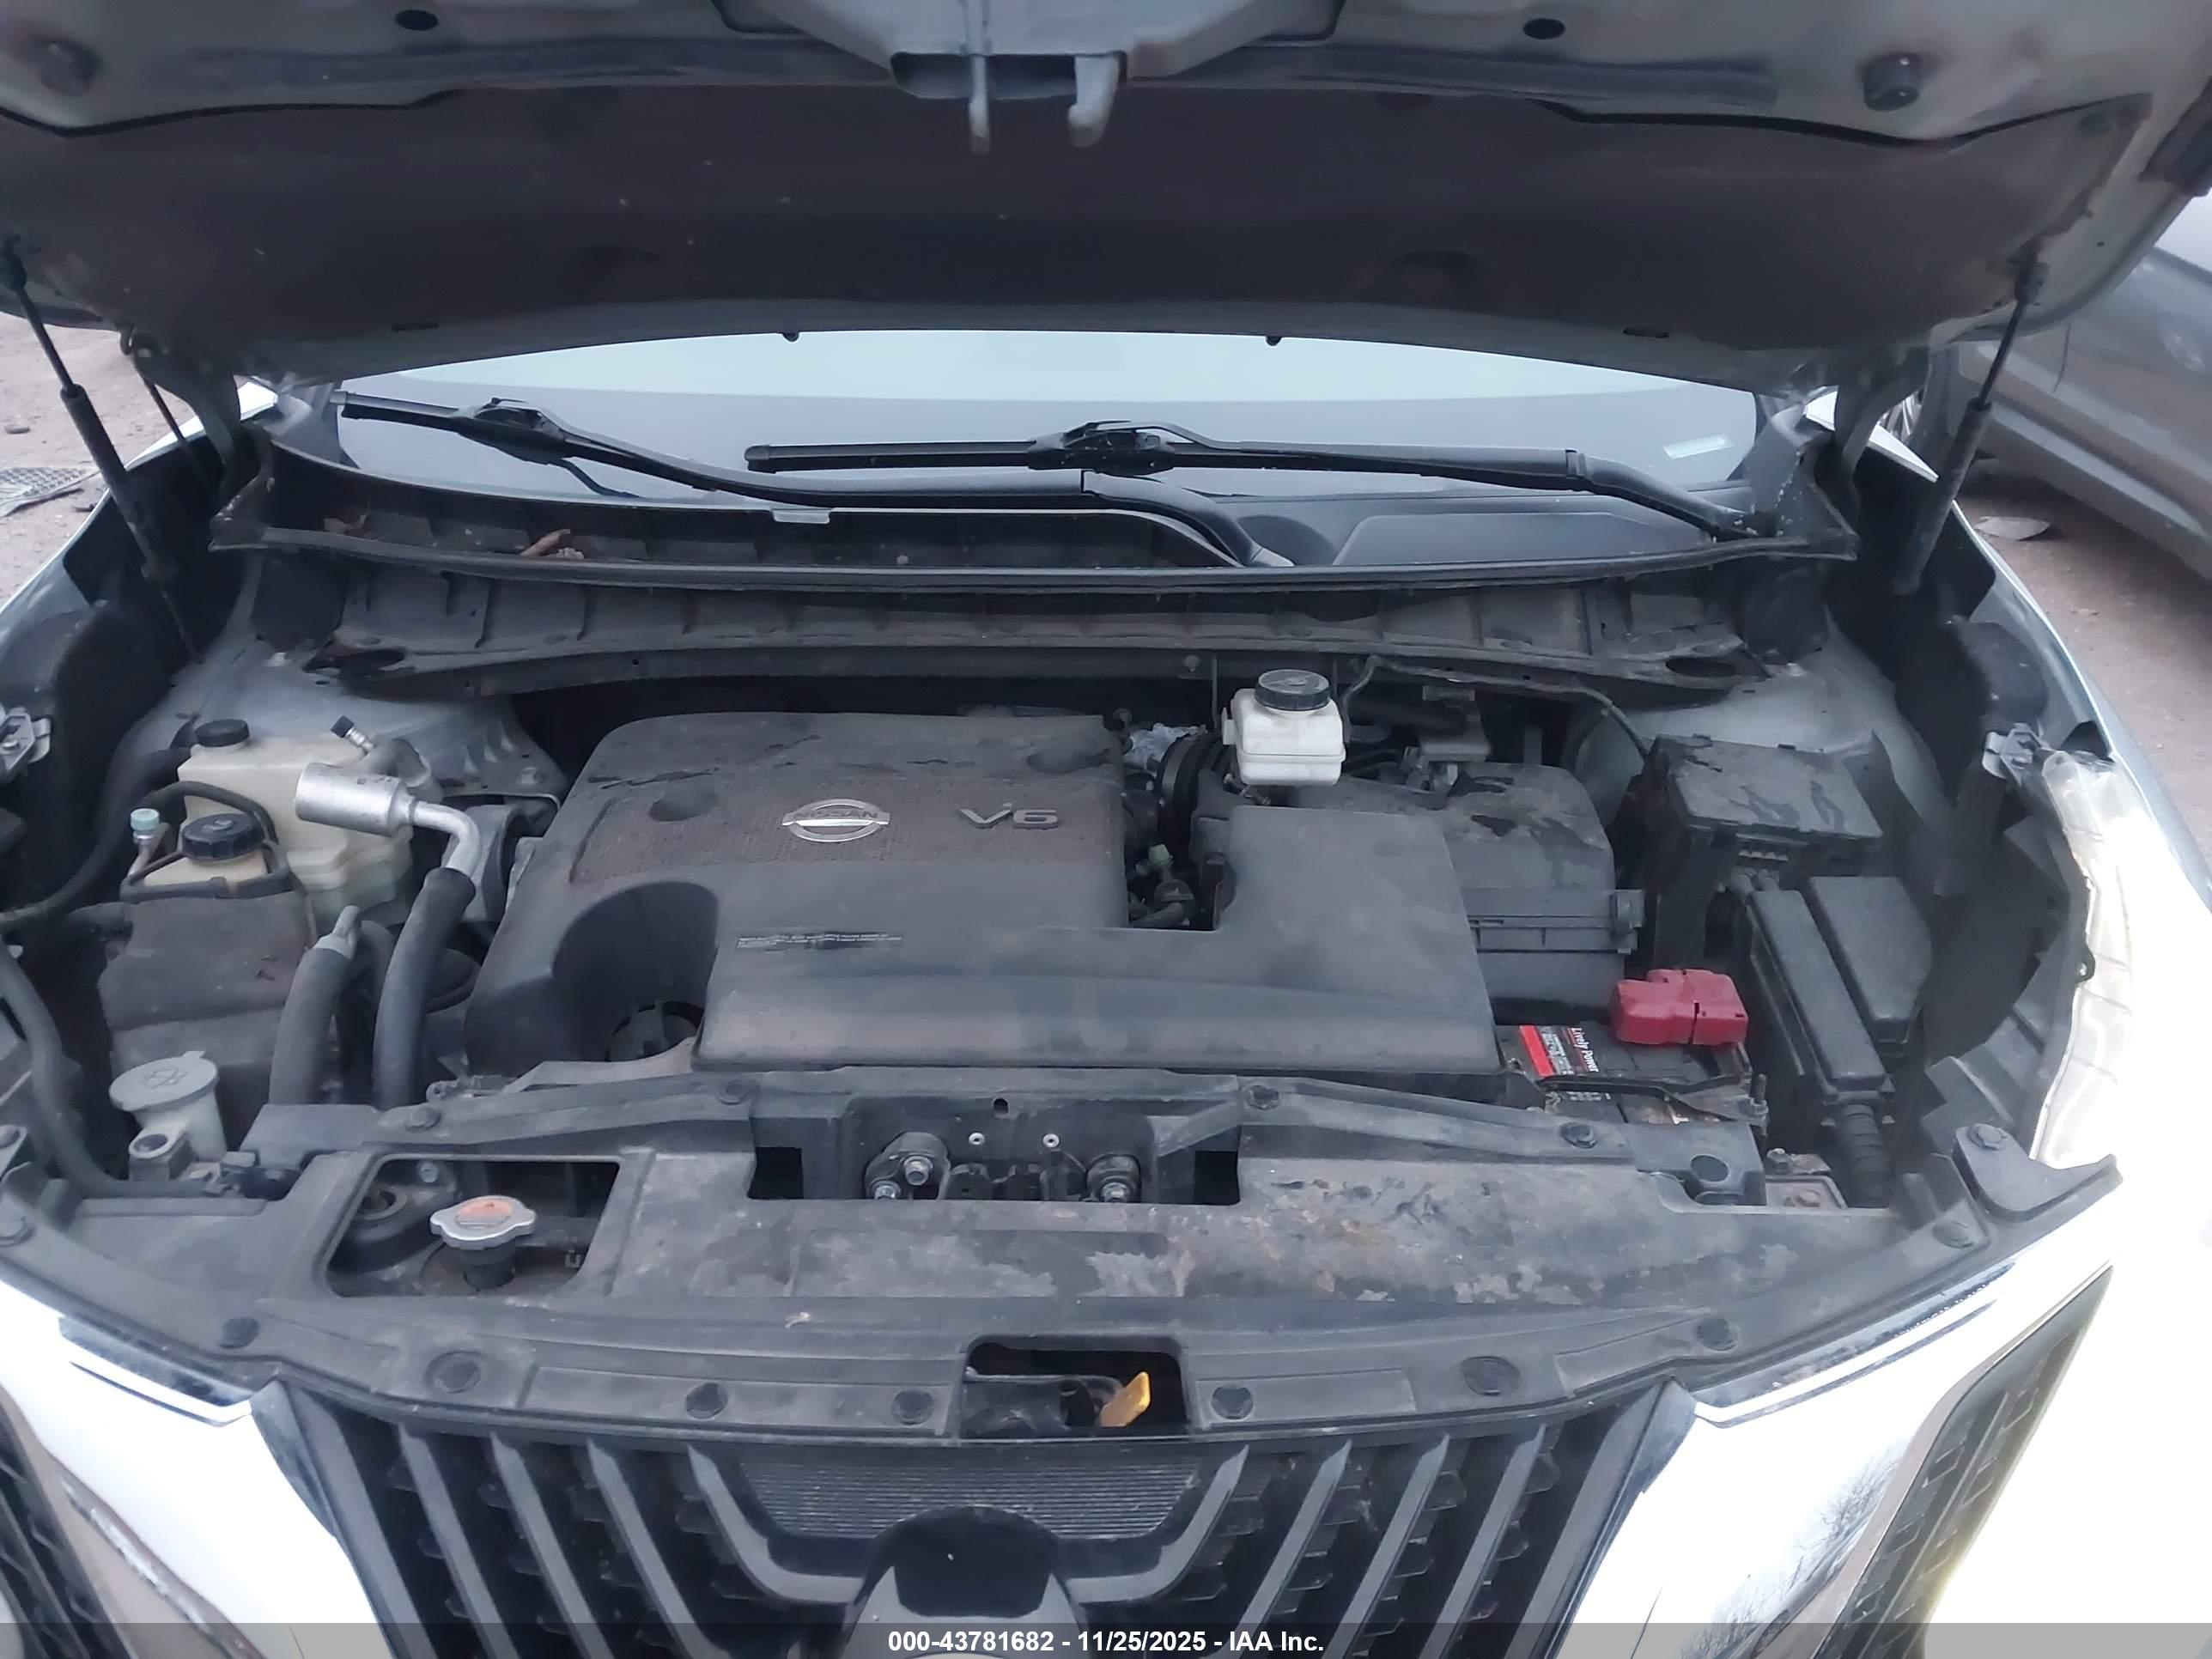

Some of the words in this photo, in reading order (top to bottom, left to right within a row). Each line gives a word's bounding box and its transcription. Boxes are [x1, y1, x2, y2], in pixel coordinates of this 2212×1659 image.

[958, 802, 1060, 830] V6
[1571, 1027, 1589, 1050] Lively
[1581, 1049, 1600, 1073] Power
